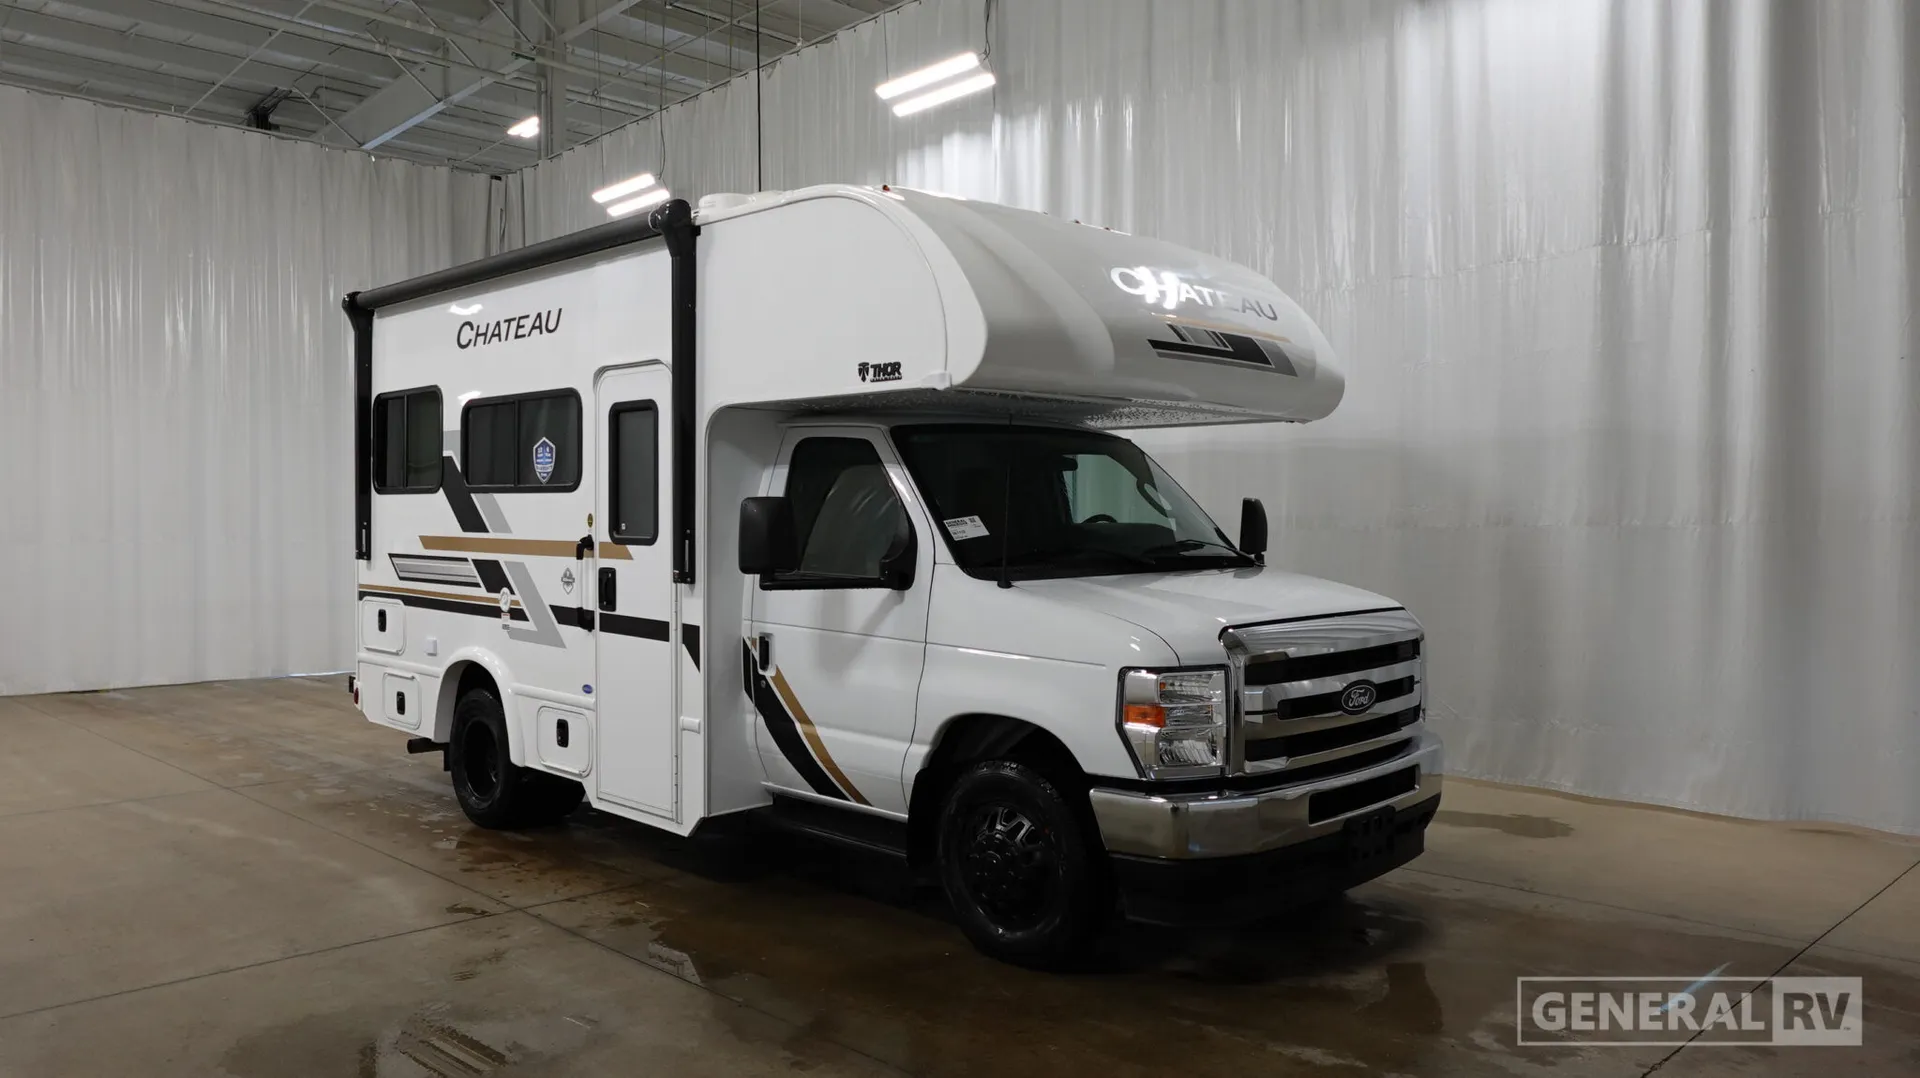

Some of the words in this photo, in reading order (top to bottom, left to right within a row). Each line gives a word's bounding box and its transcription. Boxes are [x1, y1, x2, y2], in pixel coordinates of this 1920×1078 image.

[1110, 266, 1278, 321] CHATEAU
[456, 308, 563, 349] CHATEAU
[870, 361, 902, 378] THOR
[1348, 688, 1370, 707] Ford
